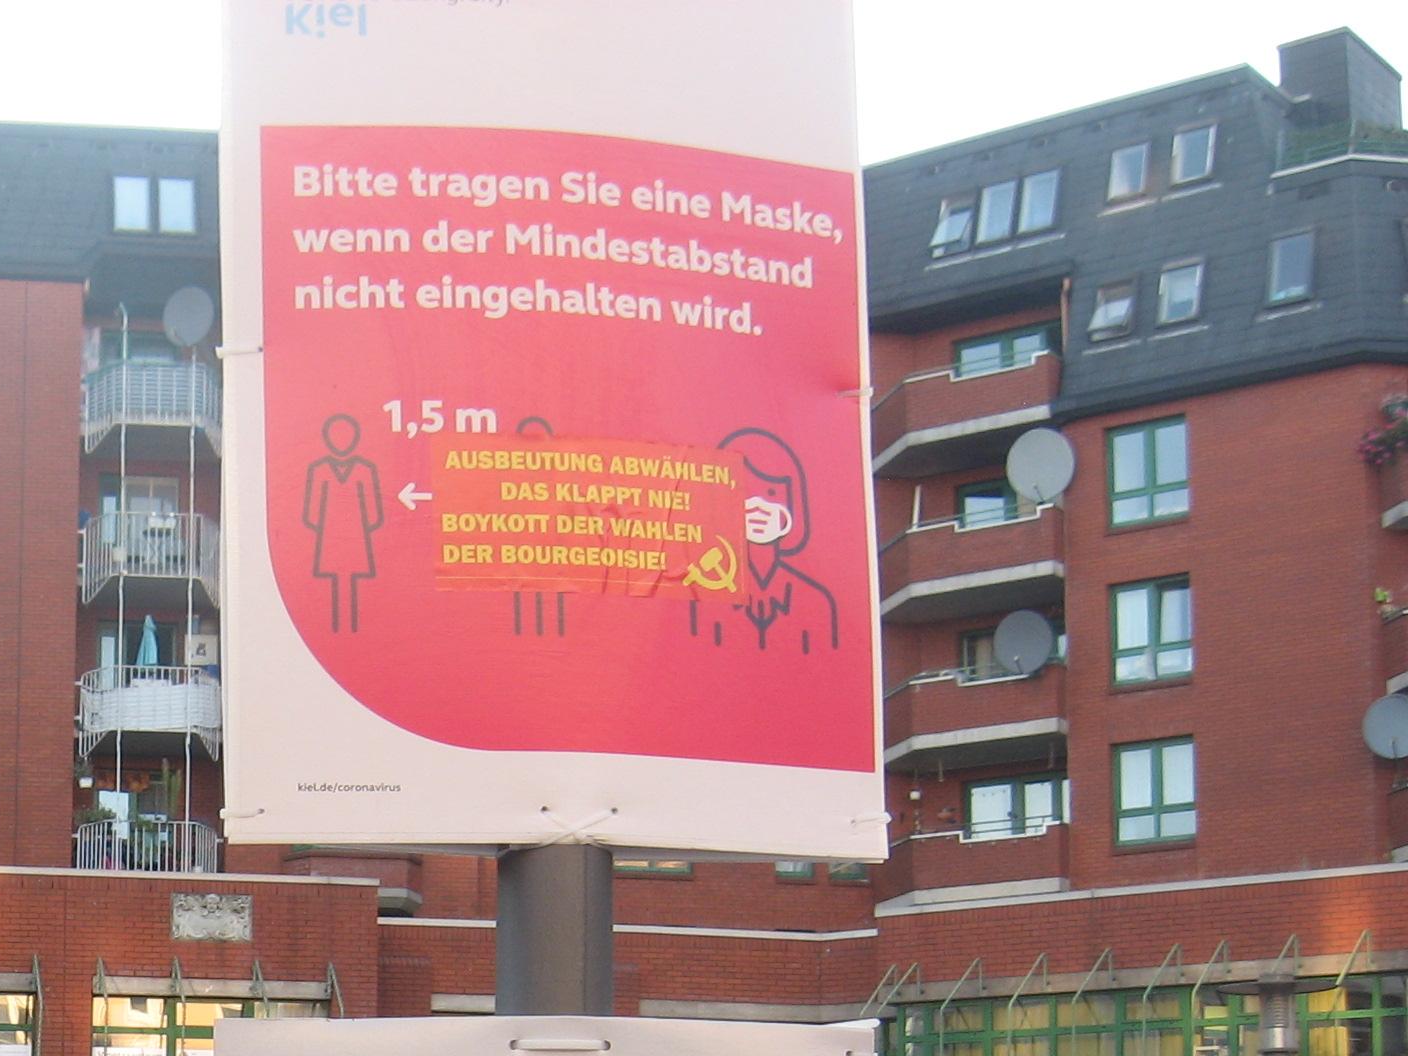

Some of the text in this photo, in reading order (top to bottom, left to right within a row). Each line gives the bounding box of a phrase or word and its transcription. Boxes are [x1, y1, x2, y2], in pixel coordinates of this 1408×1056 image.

[293, 164, 844, 245] Bitte tragen Sie eine Maske,
[293, 220, 813, 289] wenn der Mindestabstand
[295, 275, 764, 337] nicht eingehalten wird.
[382, 399, 499, 439] 1,5 m
[445, 450, 737, 489] AUSBEUTUNG ABWÄHLEN,
[500, 481, 691, 511] DAS KLAPPT NIE!
[441, 513, 703, 544] BOYKOTT DER WAHLEN
[442, 544, 668, 571] DER BOURGEOISIE!
[297, 782, 401, 794] kiel.de/coronavirus
